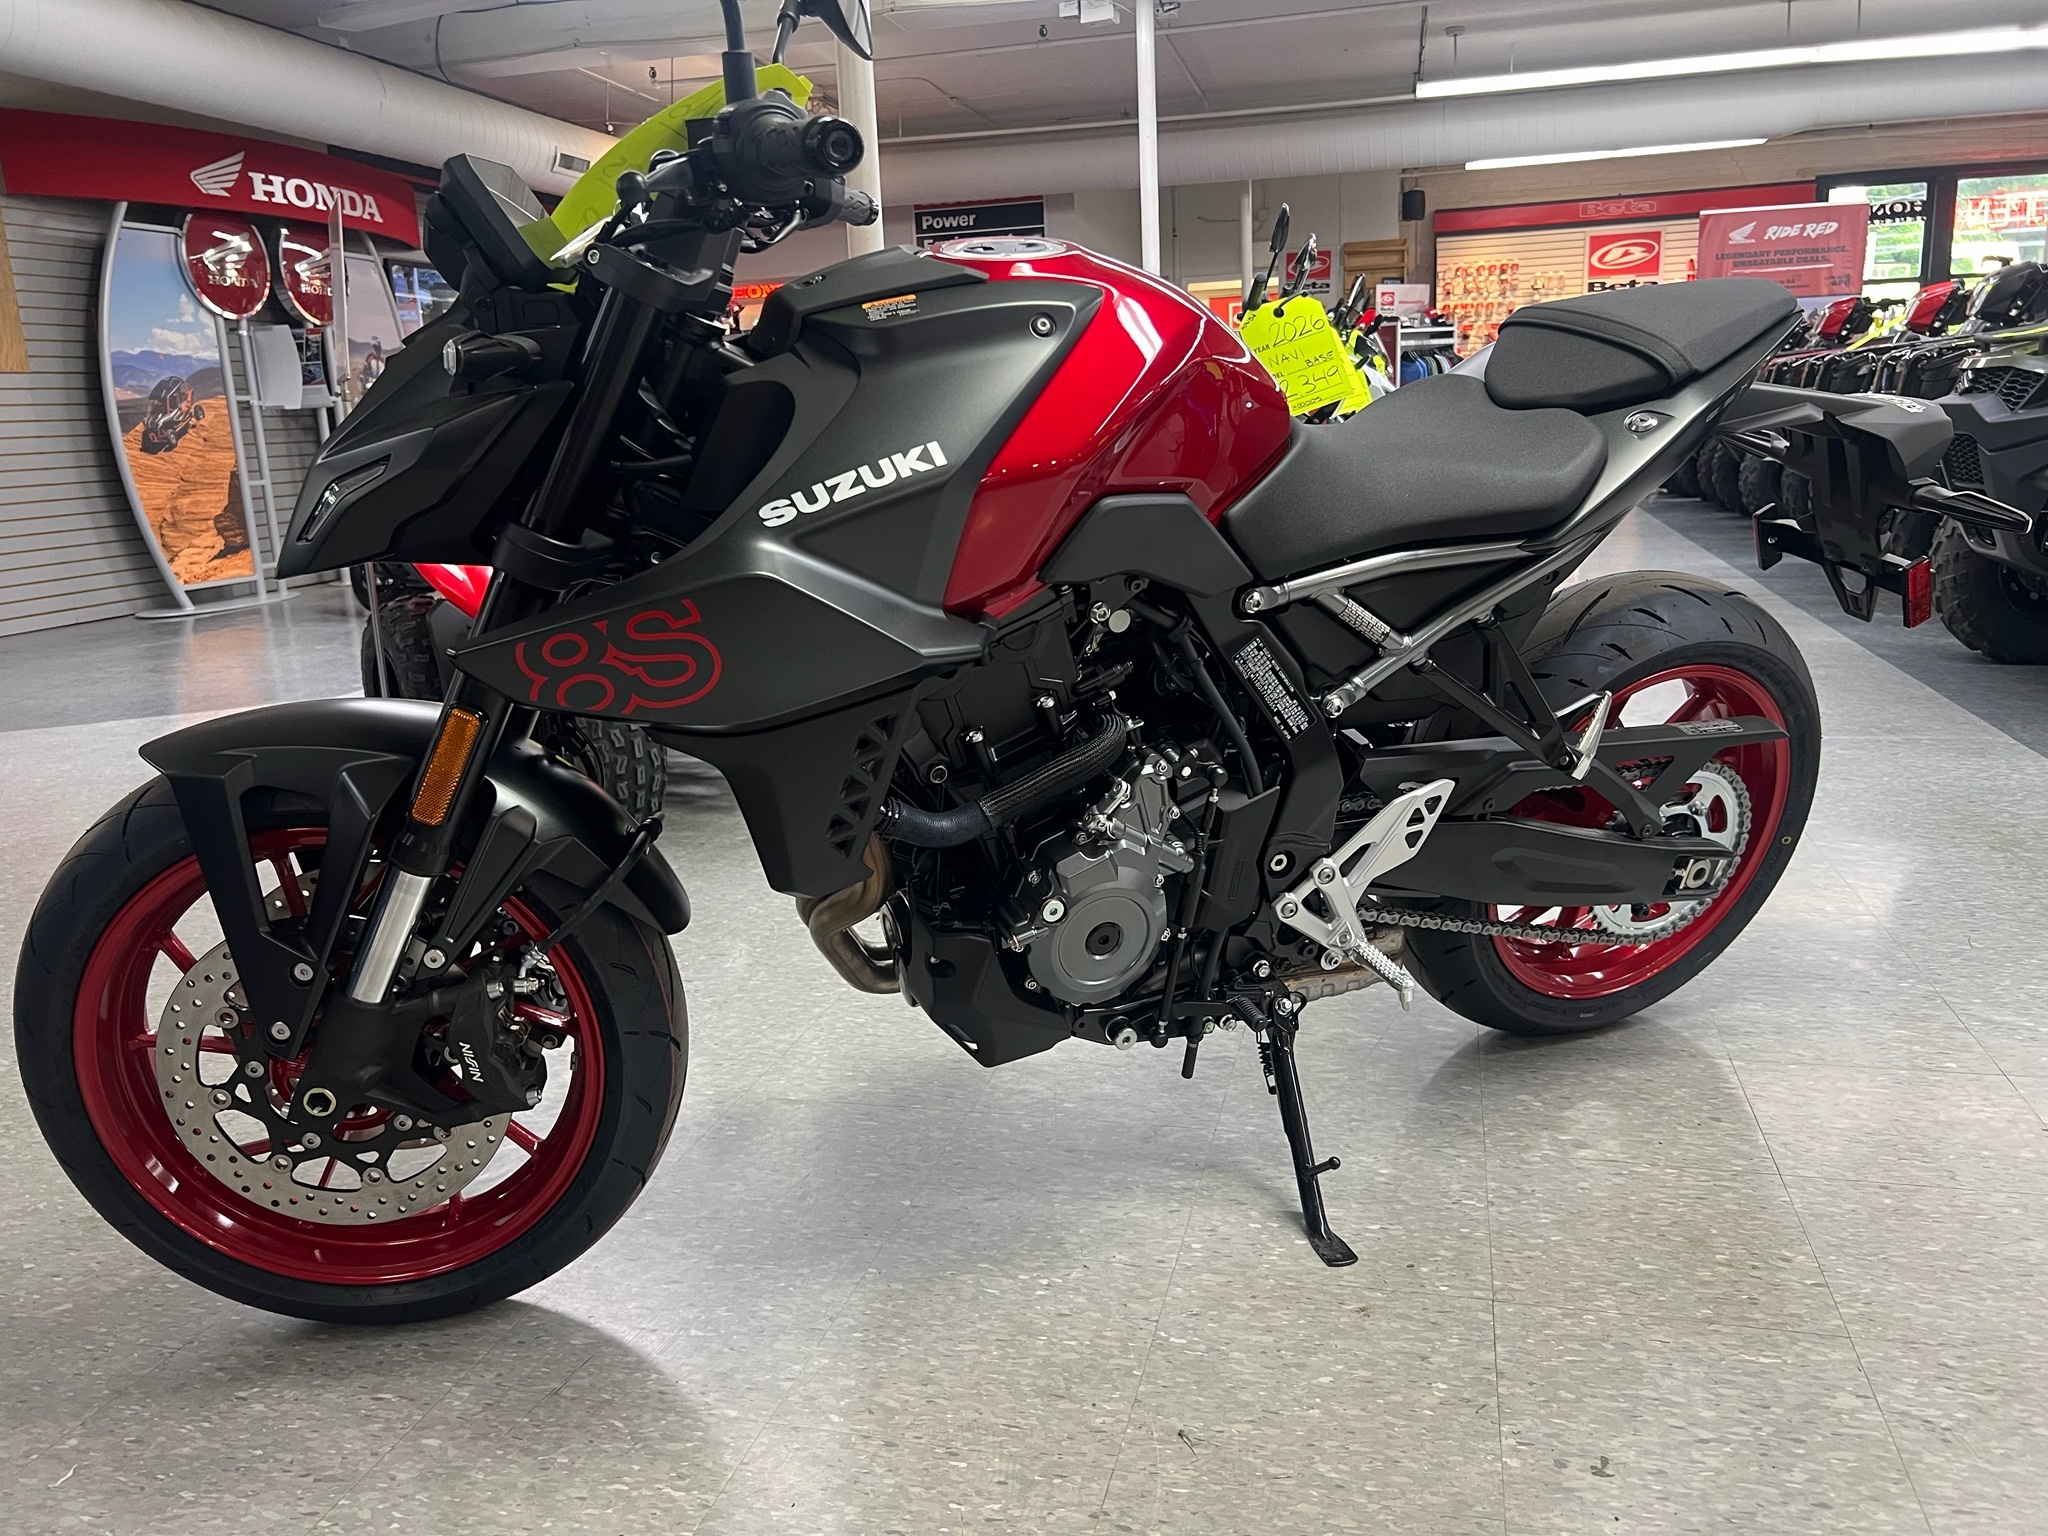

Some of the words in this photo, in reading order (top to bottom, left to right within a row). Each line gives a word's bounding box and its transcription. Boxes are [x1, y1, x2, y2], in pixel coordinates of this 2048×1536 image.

[248, 171, 384, 223] HONDA
[1580, 199, 1657, 217] Beta
[922, 214, 976, 230] Power
[1763, 223, 1804, 241] RIDE
[1803, 221, 1839, 239] RED
[1715, 250, 1772, 260] LEGENDARY
[1733, 257, 1794, 268] UNBEATABLE
[207, 274, 259, 289] HONDA
[301, 283, 333, 296] HOND
[734, 285, 781, 299] HON
[1253, 343, 1271, 354] YEAR
[1268, 313, 1326, 348] 2026
[1268, 347, 1305, 368] NAVI
[1304, 350, 1335, 367] BASE
[758, 440, 949, 528] SUZUKI
[459, 1042, 484, 1083] NISSIN
